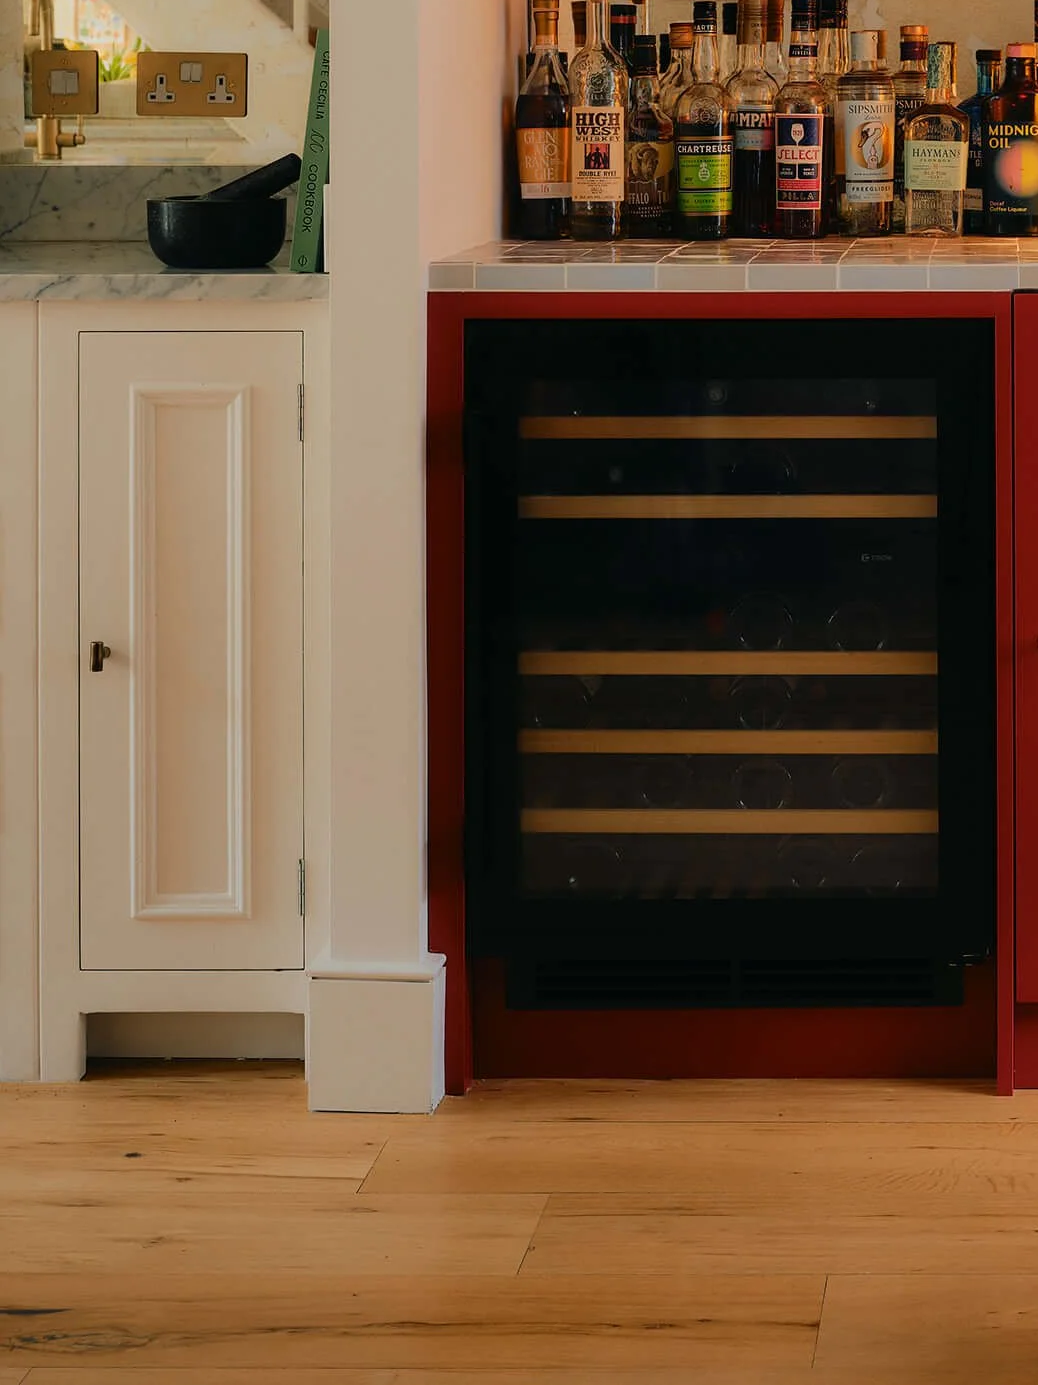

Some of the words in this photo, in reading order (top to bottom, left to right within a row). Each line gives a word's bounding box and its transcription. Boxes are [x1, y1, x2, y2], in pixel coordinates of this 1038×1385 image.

[848, 104, 893, 114] SIPSMITH
[575, 112, 621, 126] HIGH
[575, 126, 621, 136] WEST
[677, 144, 732, 154] CHARTREUSE
[989, 137, 1011, 149] OIL
[777, 149, 820, 161] SELECT
[302, 164, 319, 232] COOKBOOK
